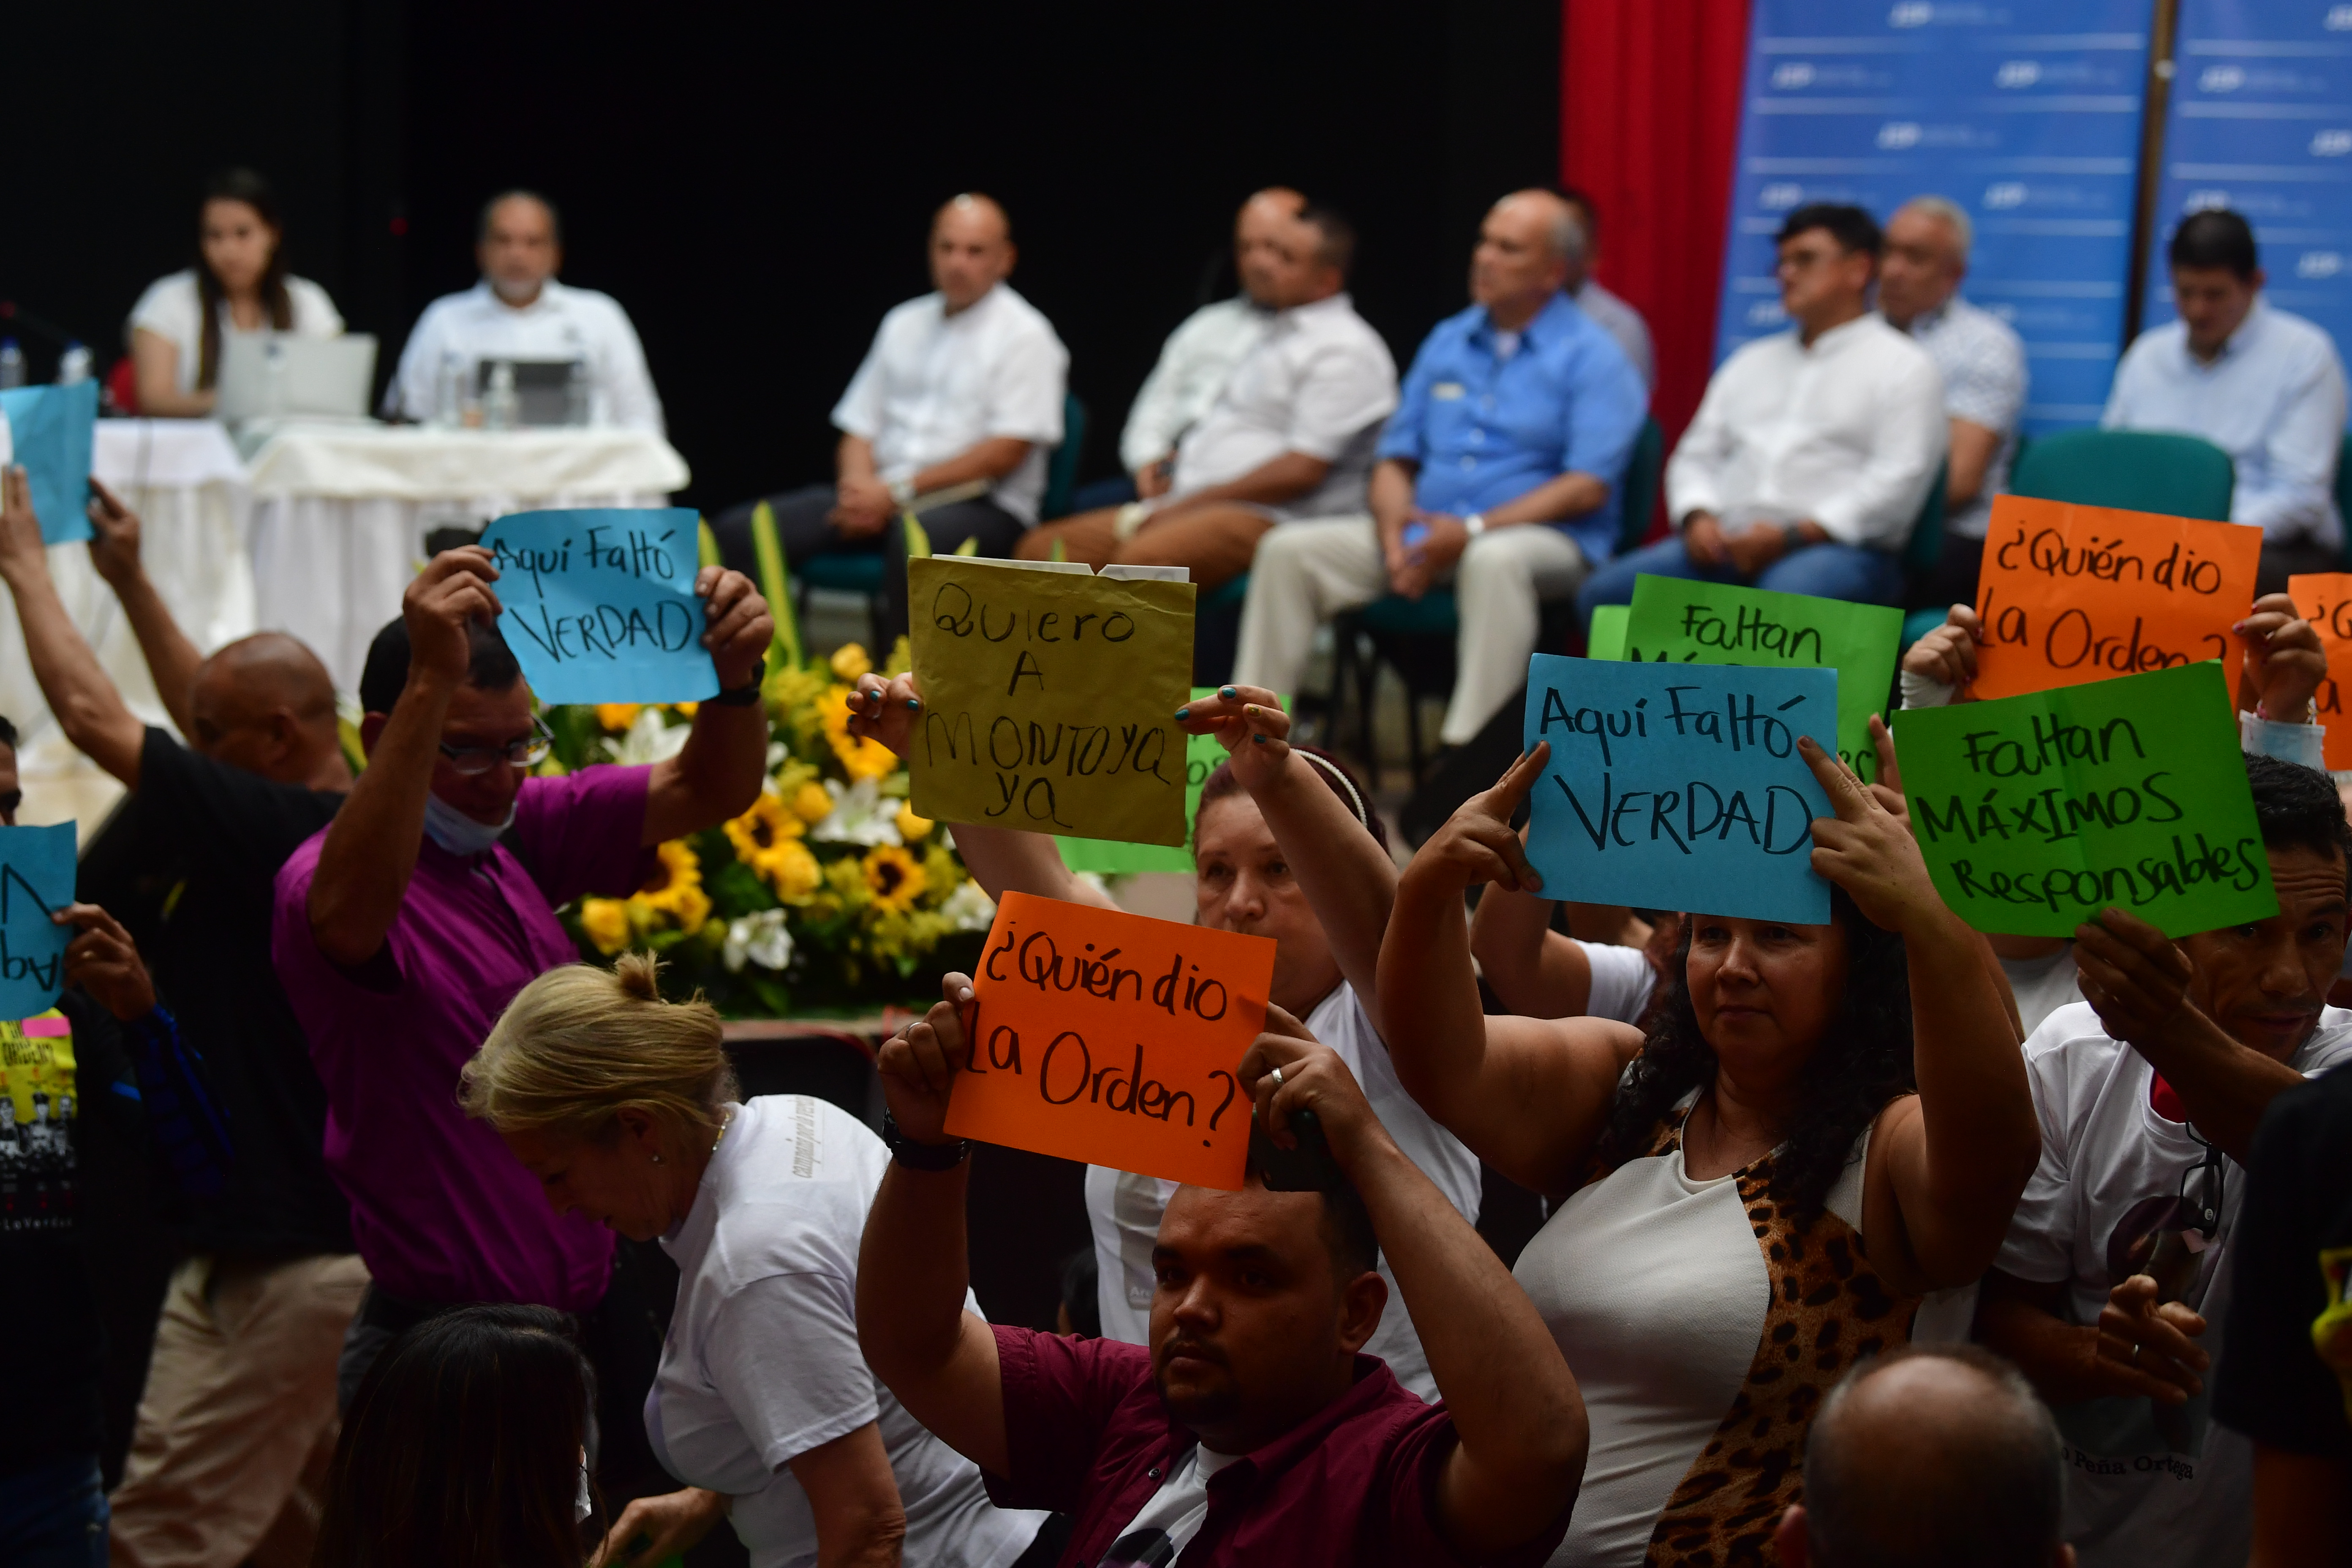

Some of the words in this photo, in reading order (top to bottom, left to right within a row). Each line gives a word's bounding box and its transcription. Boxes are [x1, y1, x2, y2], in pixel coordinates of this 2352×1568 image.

[584, 525, 675, 579] Faltó
[1998, 520, 2143, 582] ¿Quién
[2154, 542, 2221, 594] dio
[509, 600, 692, 662] VERDAD
[1681, 604, 1821, 664] Faltan
[1976, 587, 2028, 647] La
[1007, 651, 1044, 697] A
[1664, 686, 1806, 759] Faltó
[1961, 712, 2145, 777] Faltan
[1553, 772, 1813, 854] VERDAD
[1915, 772, 2183, 844] MÁXIMOS
[1950, 833, 2259, 913] Responsables
[986, 921, 1143, 1002] ¿Quién
[1153, 954, 1227, 1021] dio
[965, 1001, 1022, 1075] La
[1040, 1031, 1235, 1147] Orden?
[2074, 1450, 2126, 1474] Peña
[2134, 1455, 2194, 1480] Ortega
